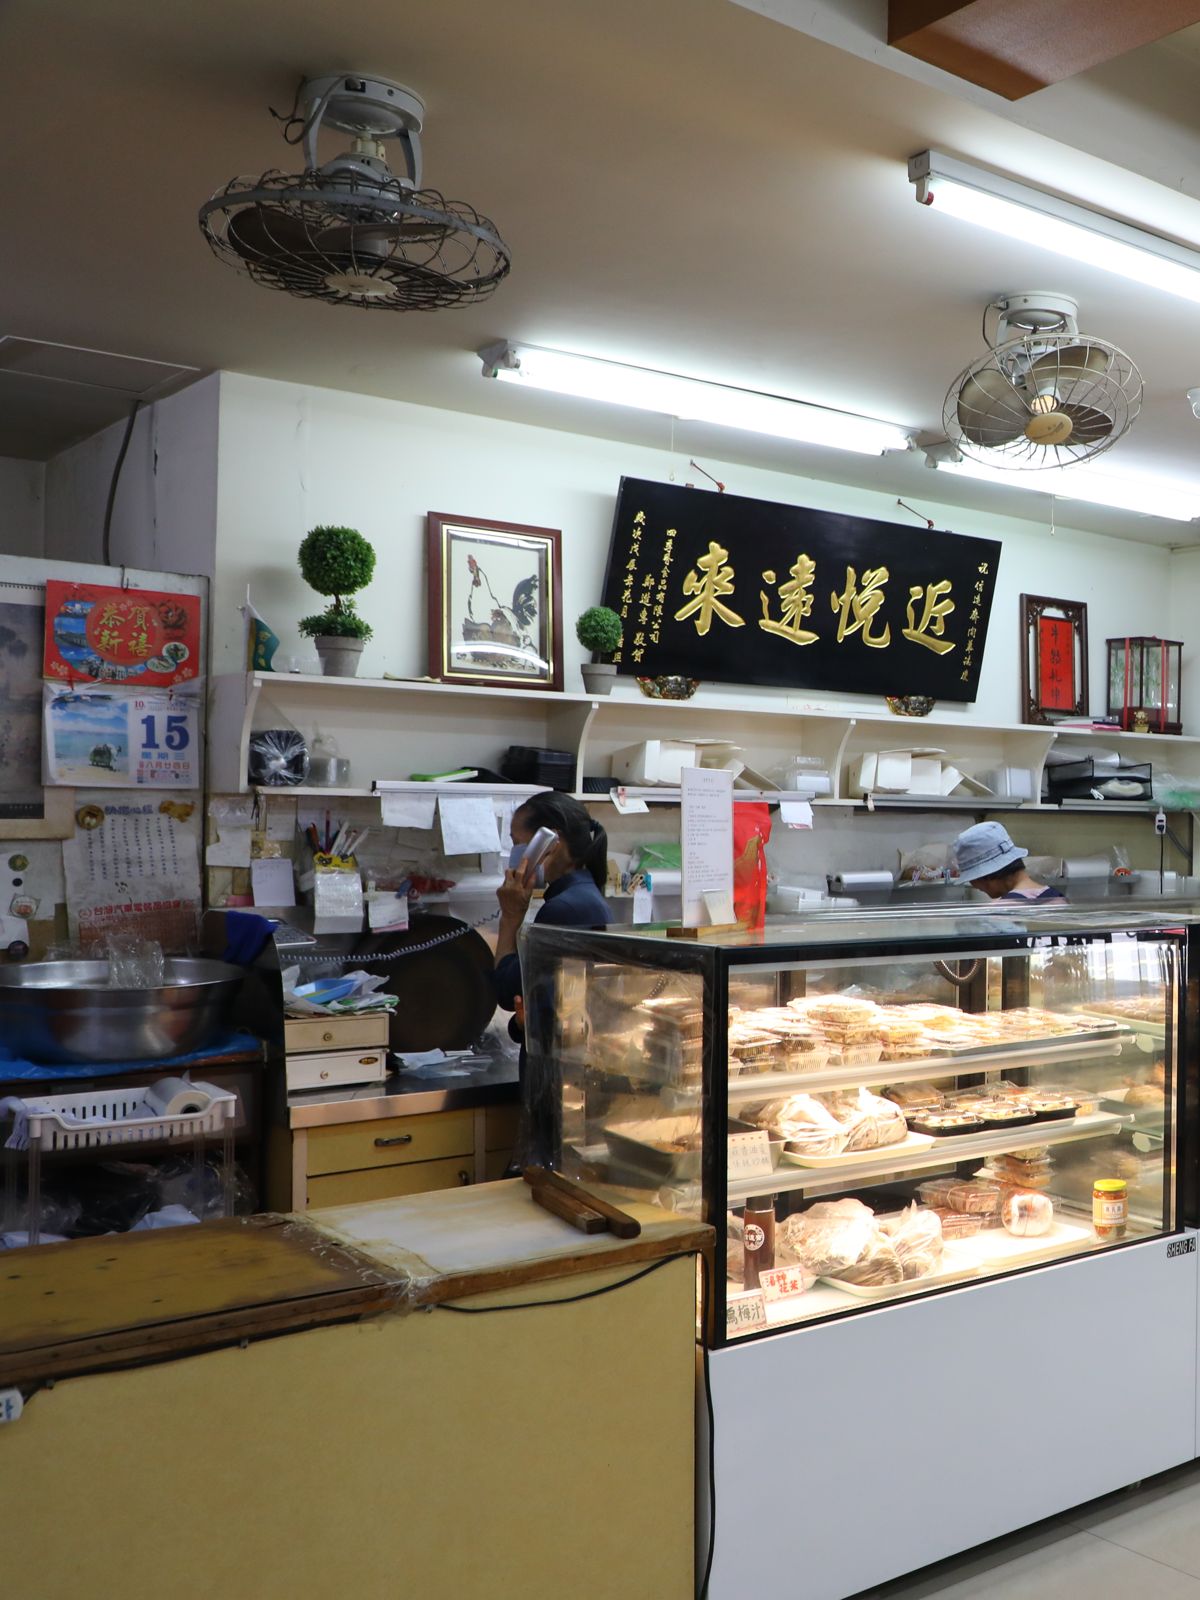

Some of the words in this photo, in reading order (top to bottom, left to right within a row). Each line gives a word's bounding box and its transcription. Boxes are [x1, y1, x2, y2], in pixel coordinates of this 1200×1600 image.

[141, 715, 190, 751] 15
[1167, 1240, 1188, 1259] SHENG
[1188, 1237, 1197, 1252] FA
